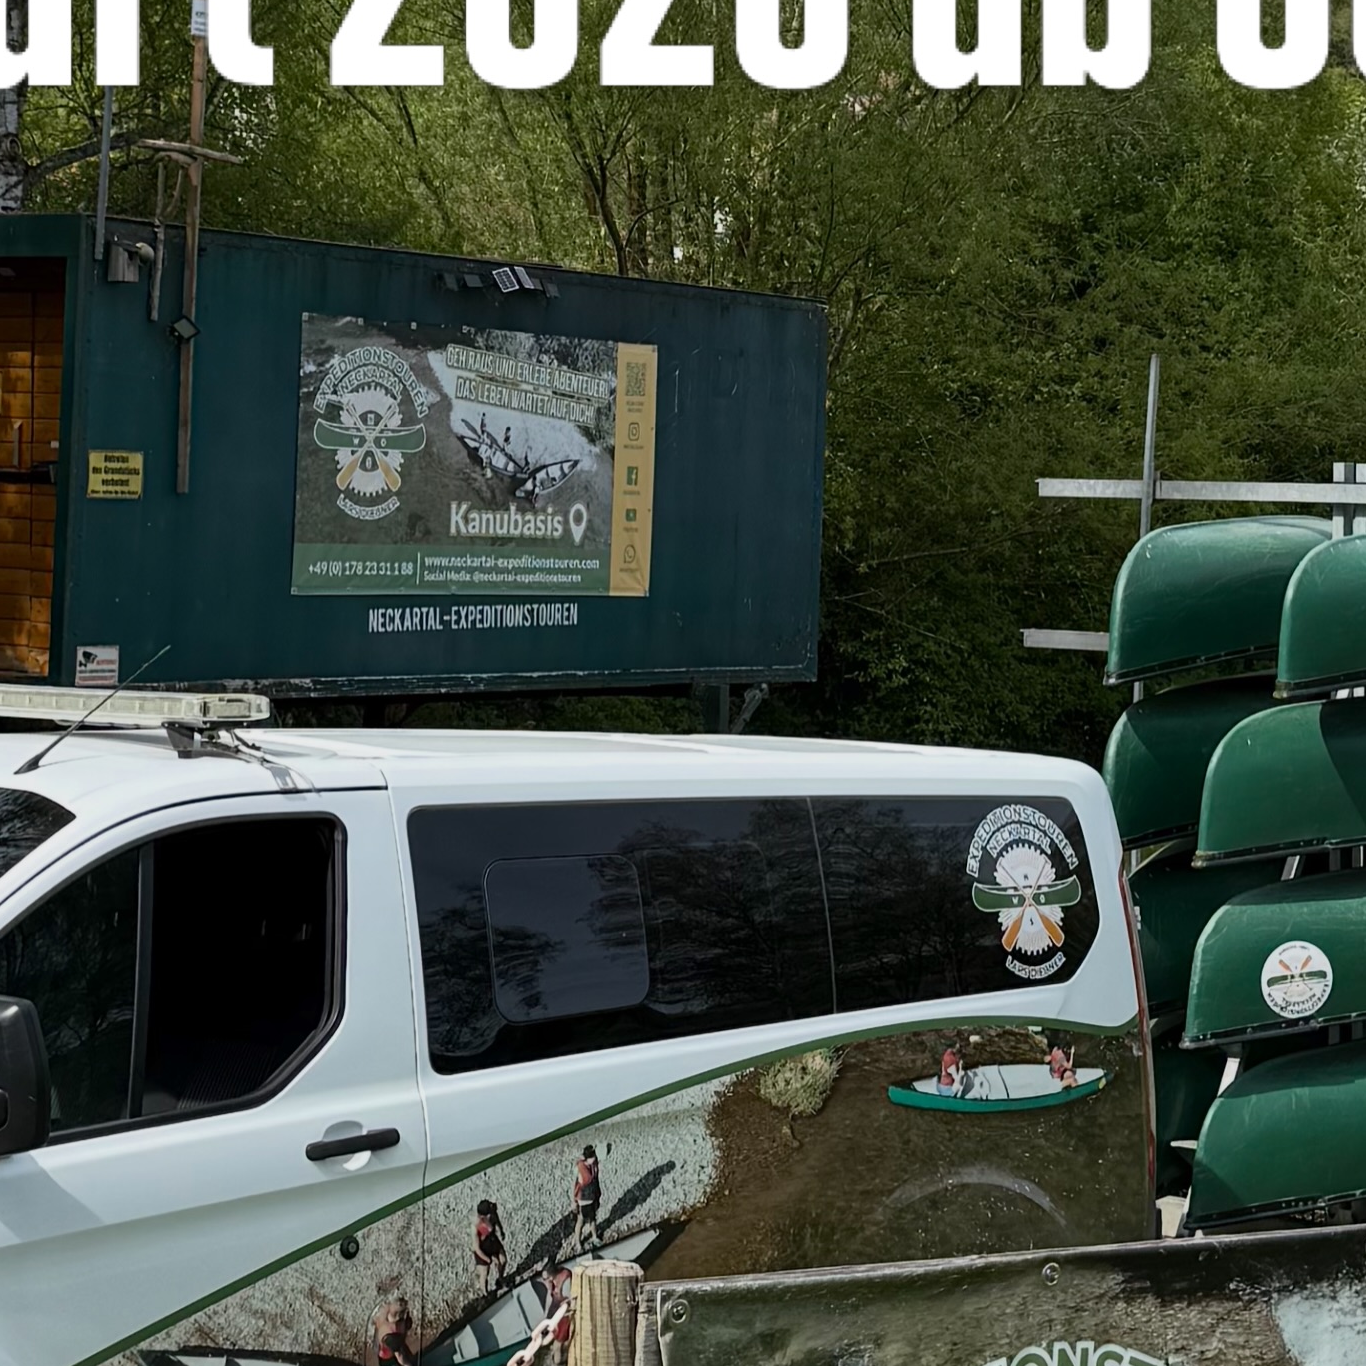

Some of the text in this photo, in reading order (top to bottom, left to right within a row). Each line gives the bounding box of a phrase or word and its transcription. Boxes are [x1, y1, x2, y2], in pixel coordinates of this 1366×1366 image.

[313, 346, 428, 417] EXPEDITIONSTOUREN
[336, 366, 403, 401] NECKARTAL
[447, 347, 608, 398] GEH RAUS UND ERLEBE ABENTEUER!
[457, 379, 595, 424] DAS LEBEN WARTET AUF DICH!
[450, 501, 563, 538] Kanubasis
[309, 561, 413, 577] +49 (0) 178 23 31 1 88
[369, 603, 578, 633] NECKARTAL-EXPEDITIONSTOUREN
[966, 804, 1079, 877] EXPEDITIONSTOUREN
[986, 823, 1052, 858] NECKARTAL
